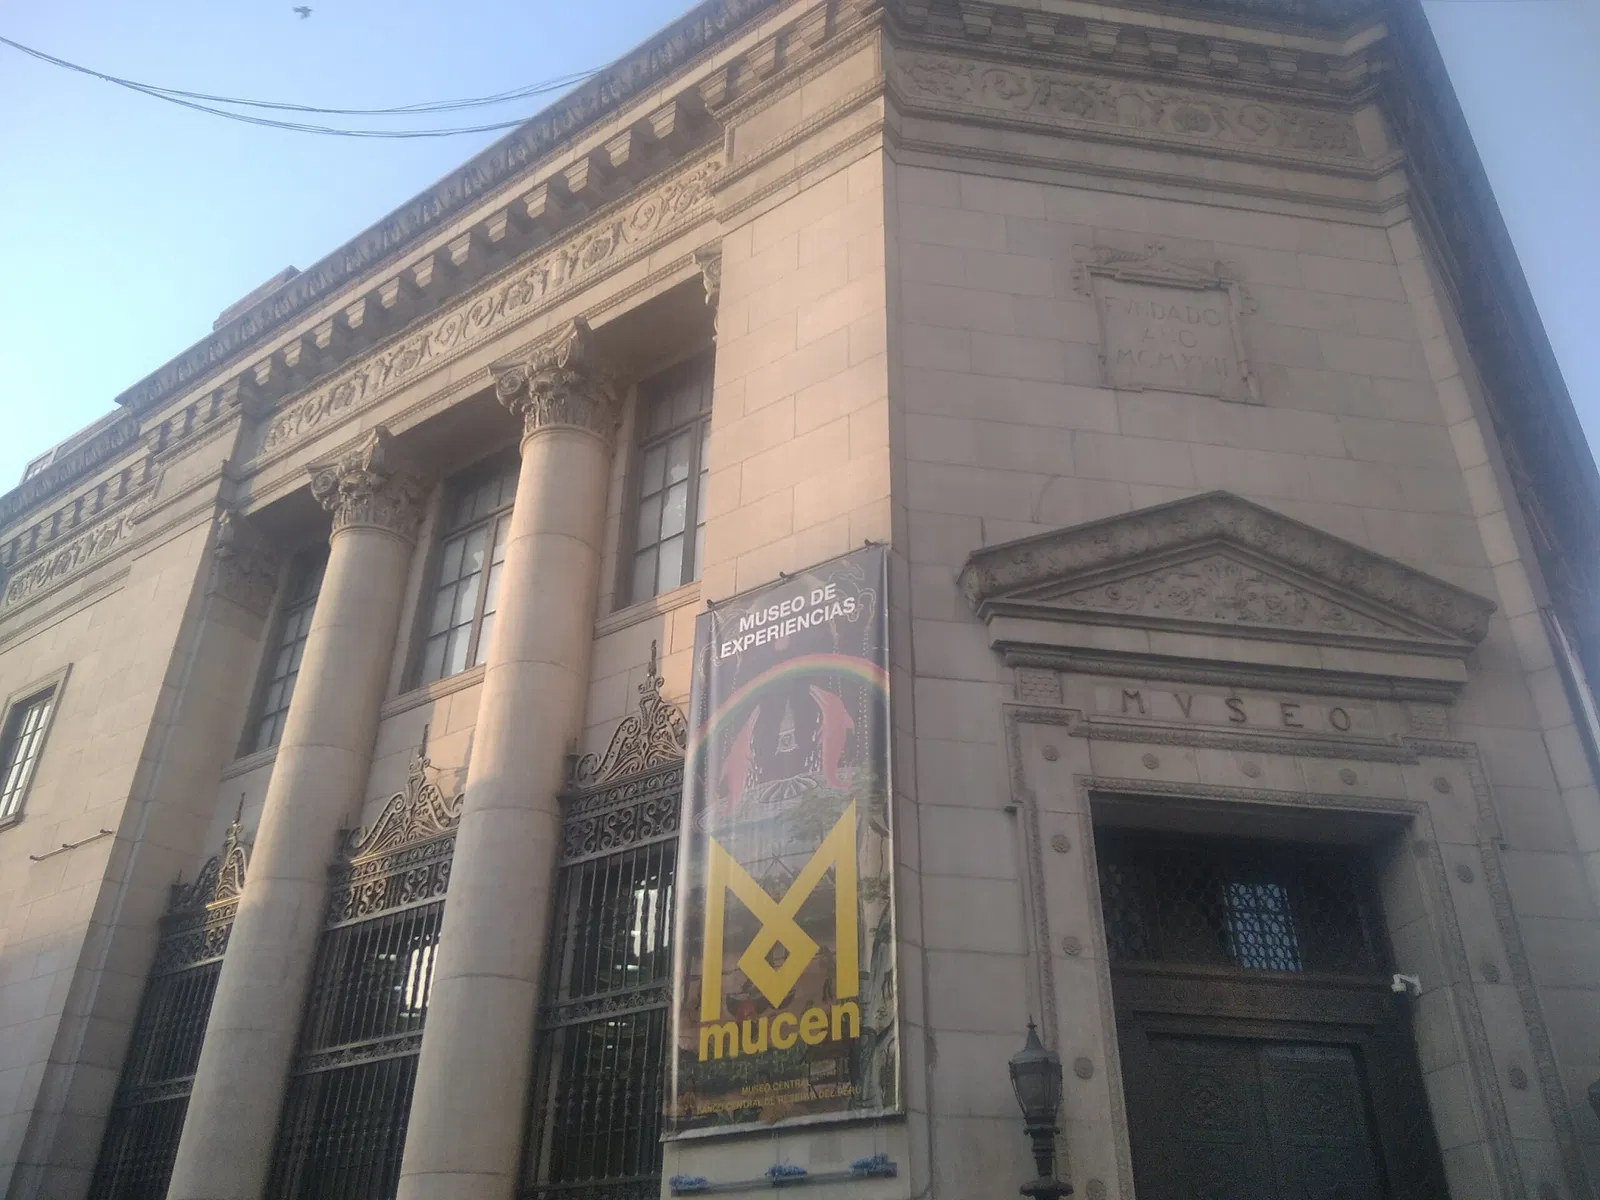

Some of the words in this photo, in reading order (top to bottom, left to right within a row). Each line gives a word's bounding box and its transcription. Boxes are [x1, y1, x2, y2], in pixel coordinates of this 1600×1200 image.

[720, 597, 856, 658] EXPERIENCIAS
[739, 596, 805, 632] MUSEO
[811, 583, 836, 606] DE
[1121, 688, 1351, 732] MVSEO
[698, 1001, 862, 1061] mucen
[696, 1103, 724, 1115] BANCO
[764, 1095, 777, 1106] DE
[742, 1083, 771, 1095] MUSEO
[772, 1078, 811, 1091] CENTRAL
